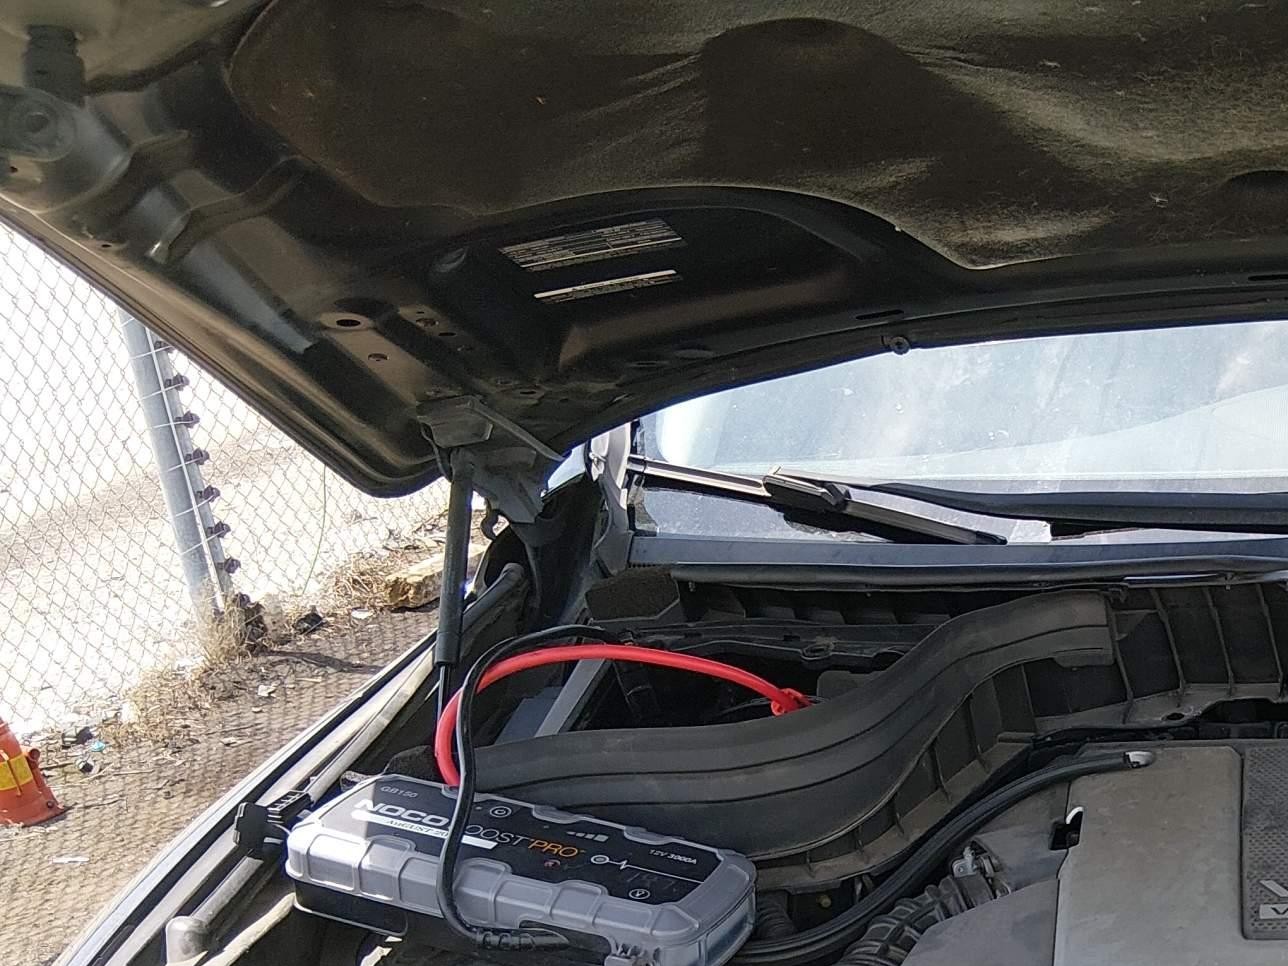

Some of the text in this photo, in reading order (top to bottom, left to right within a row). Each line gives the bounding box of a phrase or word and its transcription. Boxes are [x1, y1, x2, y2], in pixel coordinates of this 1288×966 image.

[380, 786, 418, 798] GB150
[354, 799, 579, 858] NOCO OOST PRO
[387, 819, 431, 835] AUGUST
[650, 849, 669, 857] 12V
